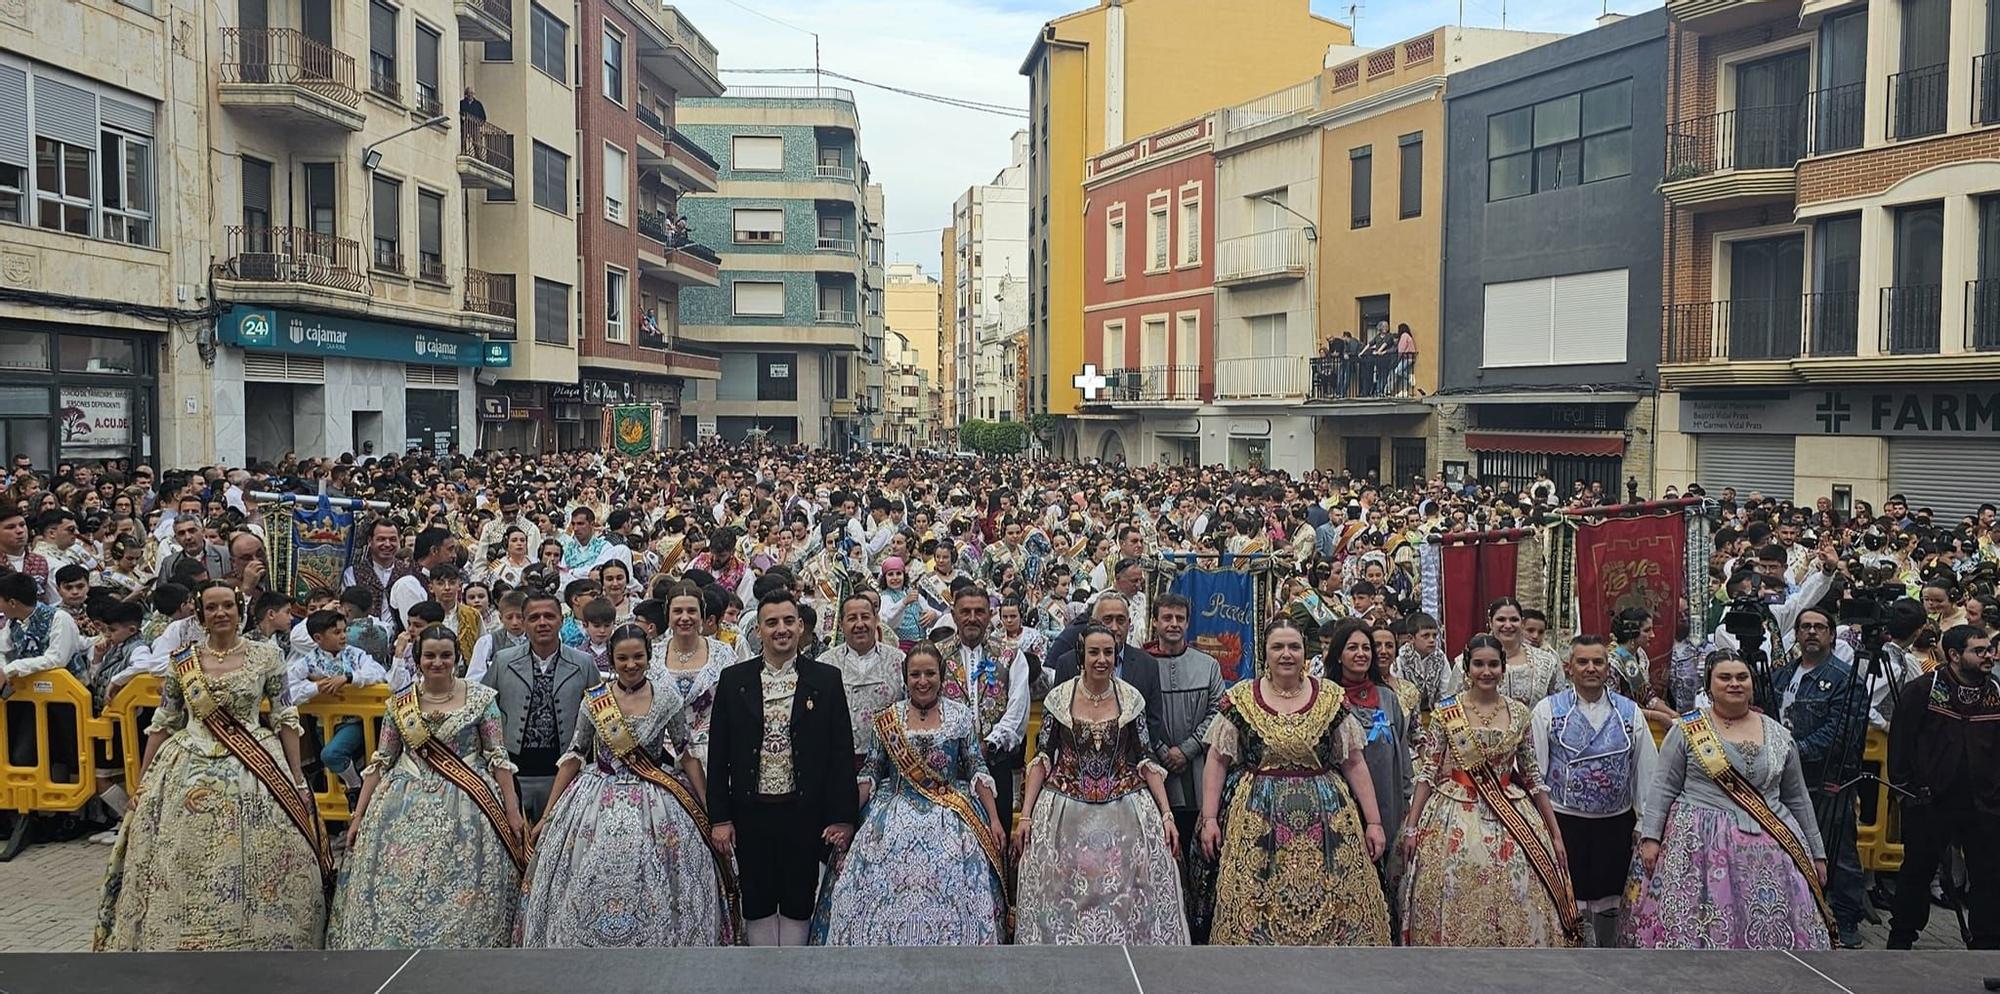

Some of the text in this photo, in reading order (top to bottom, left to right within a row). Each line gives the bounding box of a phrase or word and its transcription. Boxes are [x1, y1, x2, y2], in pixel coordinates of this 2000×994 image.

[306, 323, 348, 347] cajamar
[427, 338, 457, 358] cajamar
[1703, 421, 1727, 429] Carmen
[1728, 421, 1744, 429] Vidal
[1746, 421, 1762, 429] Prats
